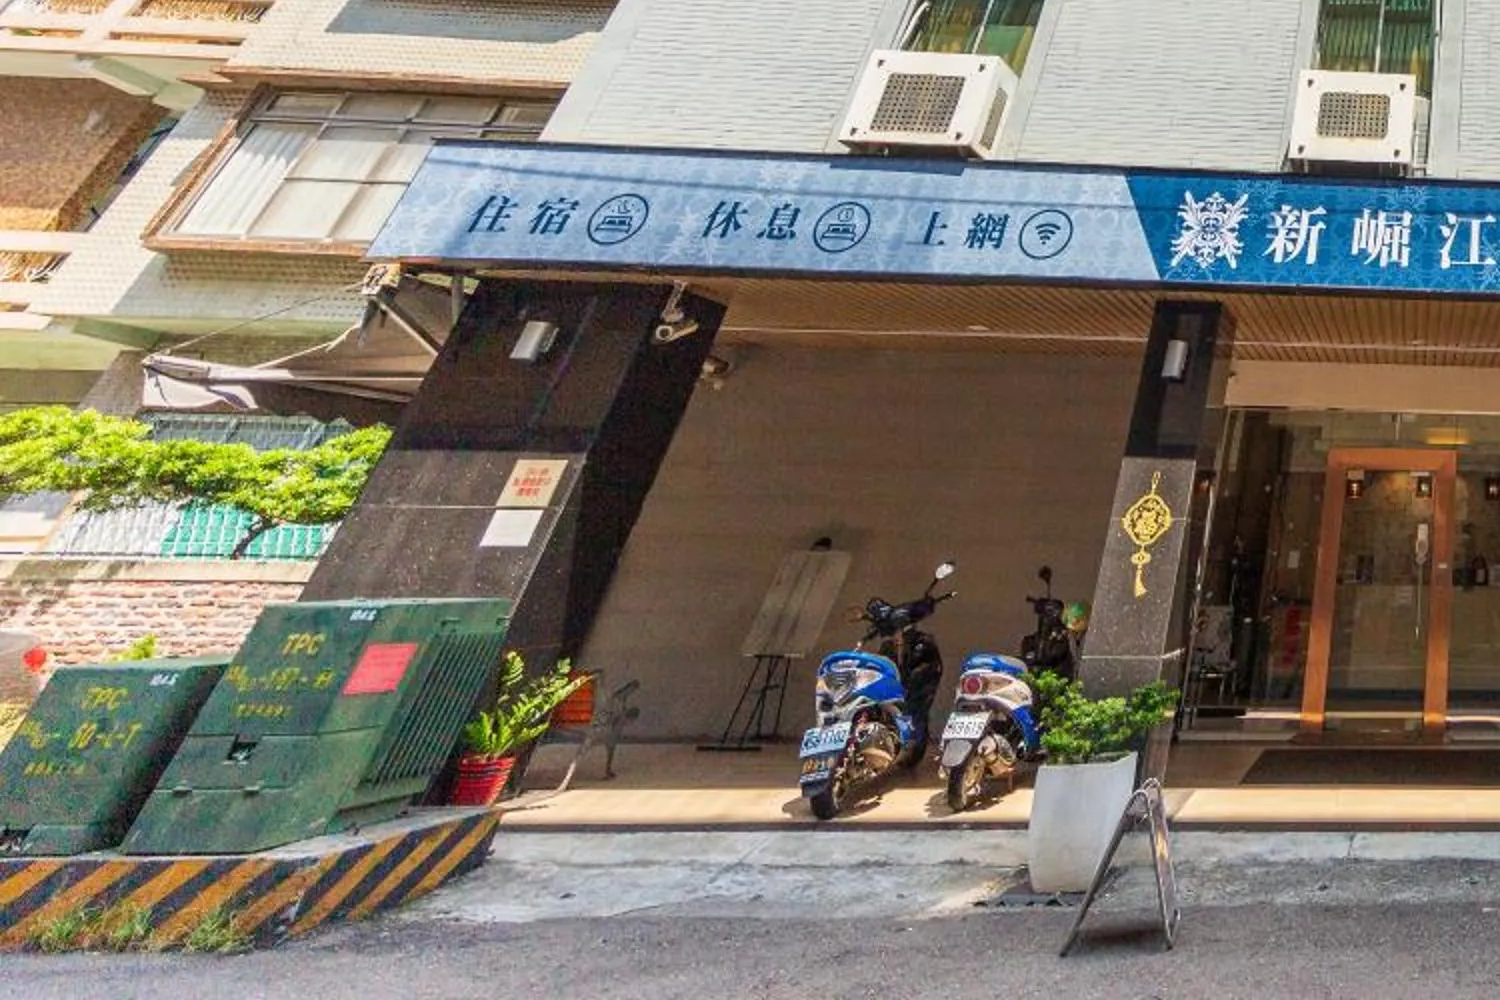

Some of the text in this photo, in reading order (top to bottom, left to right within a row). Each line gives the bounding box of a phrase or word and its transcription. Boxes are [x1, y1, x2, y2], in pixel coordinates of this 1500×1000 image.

[466, 195, 581, 236] 住宿
[701, 199, 798, 242] 休息
[904, 211, 1009, 250] 上網
[281, 631, 326, 656] TPC
